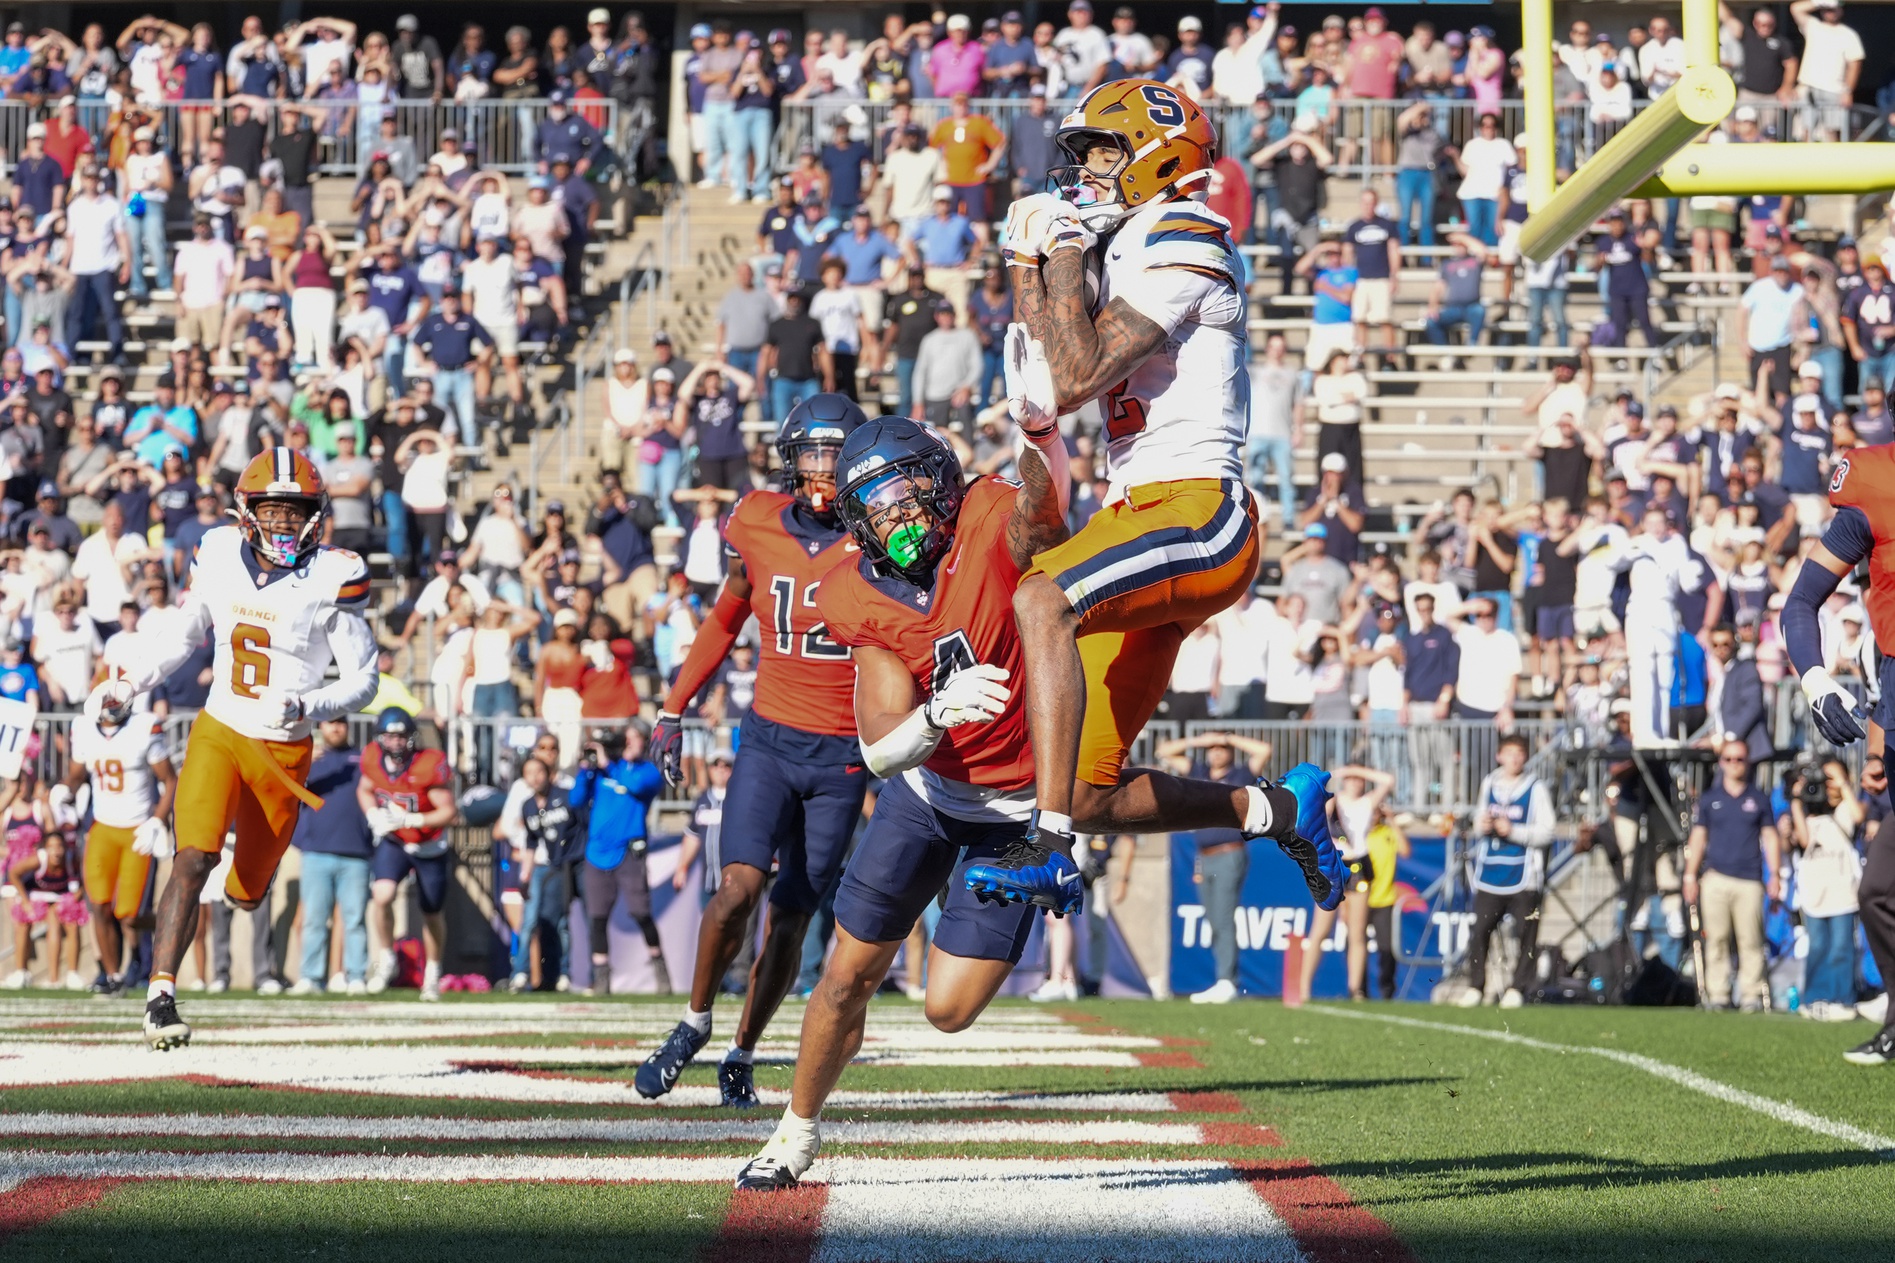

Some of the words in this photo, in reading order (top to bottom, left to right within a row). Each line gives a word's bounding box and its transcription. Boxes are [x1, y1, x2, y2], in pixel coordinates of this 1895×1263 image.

[1139, 84, 1187, 128] S
[769, 575, 852, 660] 12
[230, 621, 272, 701] 6
[94, 758, 124, 794] 19
[1177, 903, 1379, 954] TAVEL
